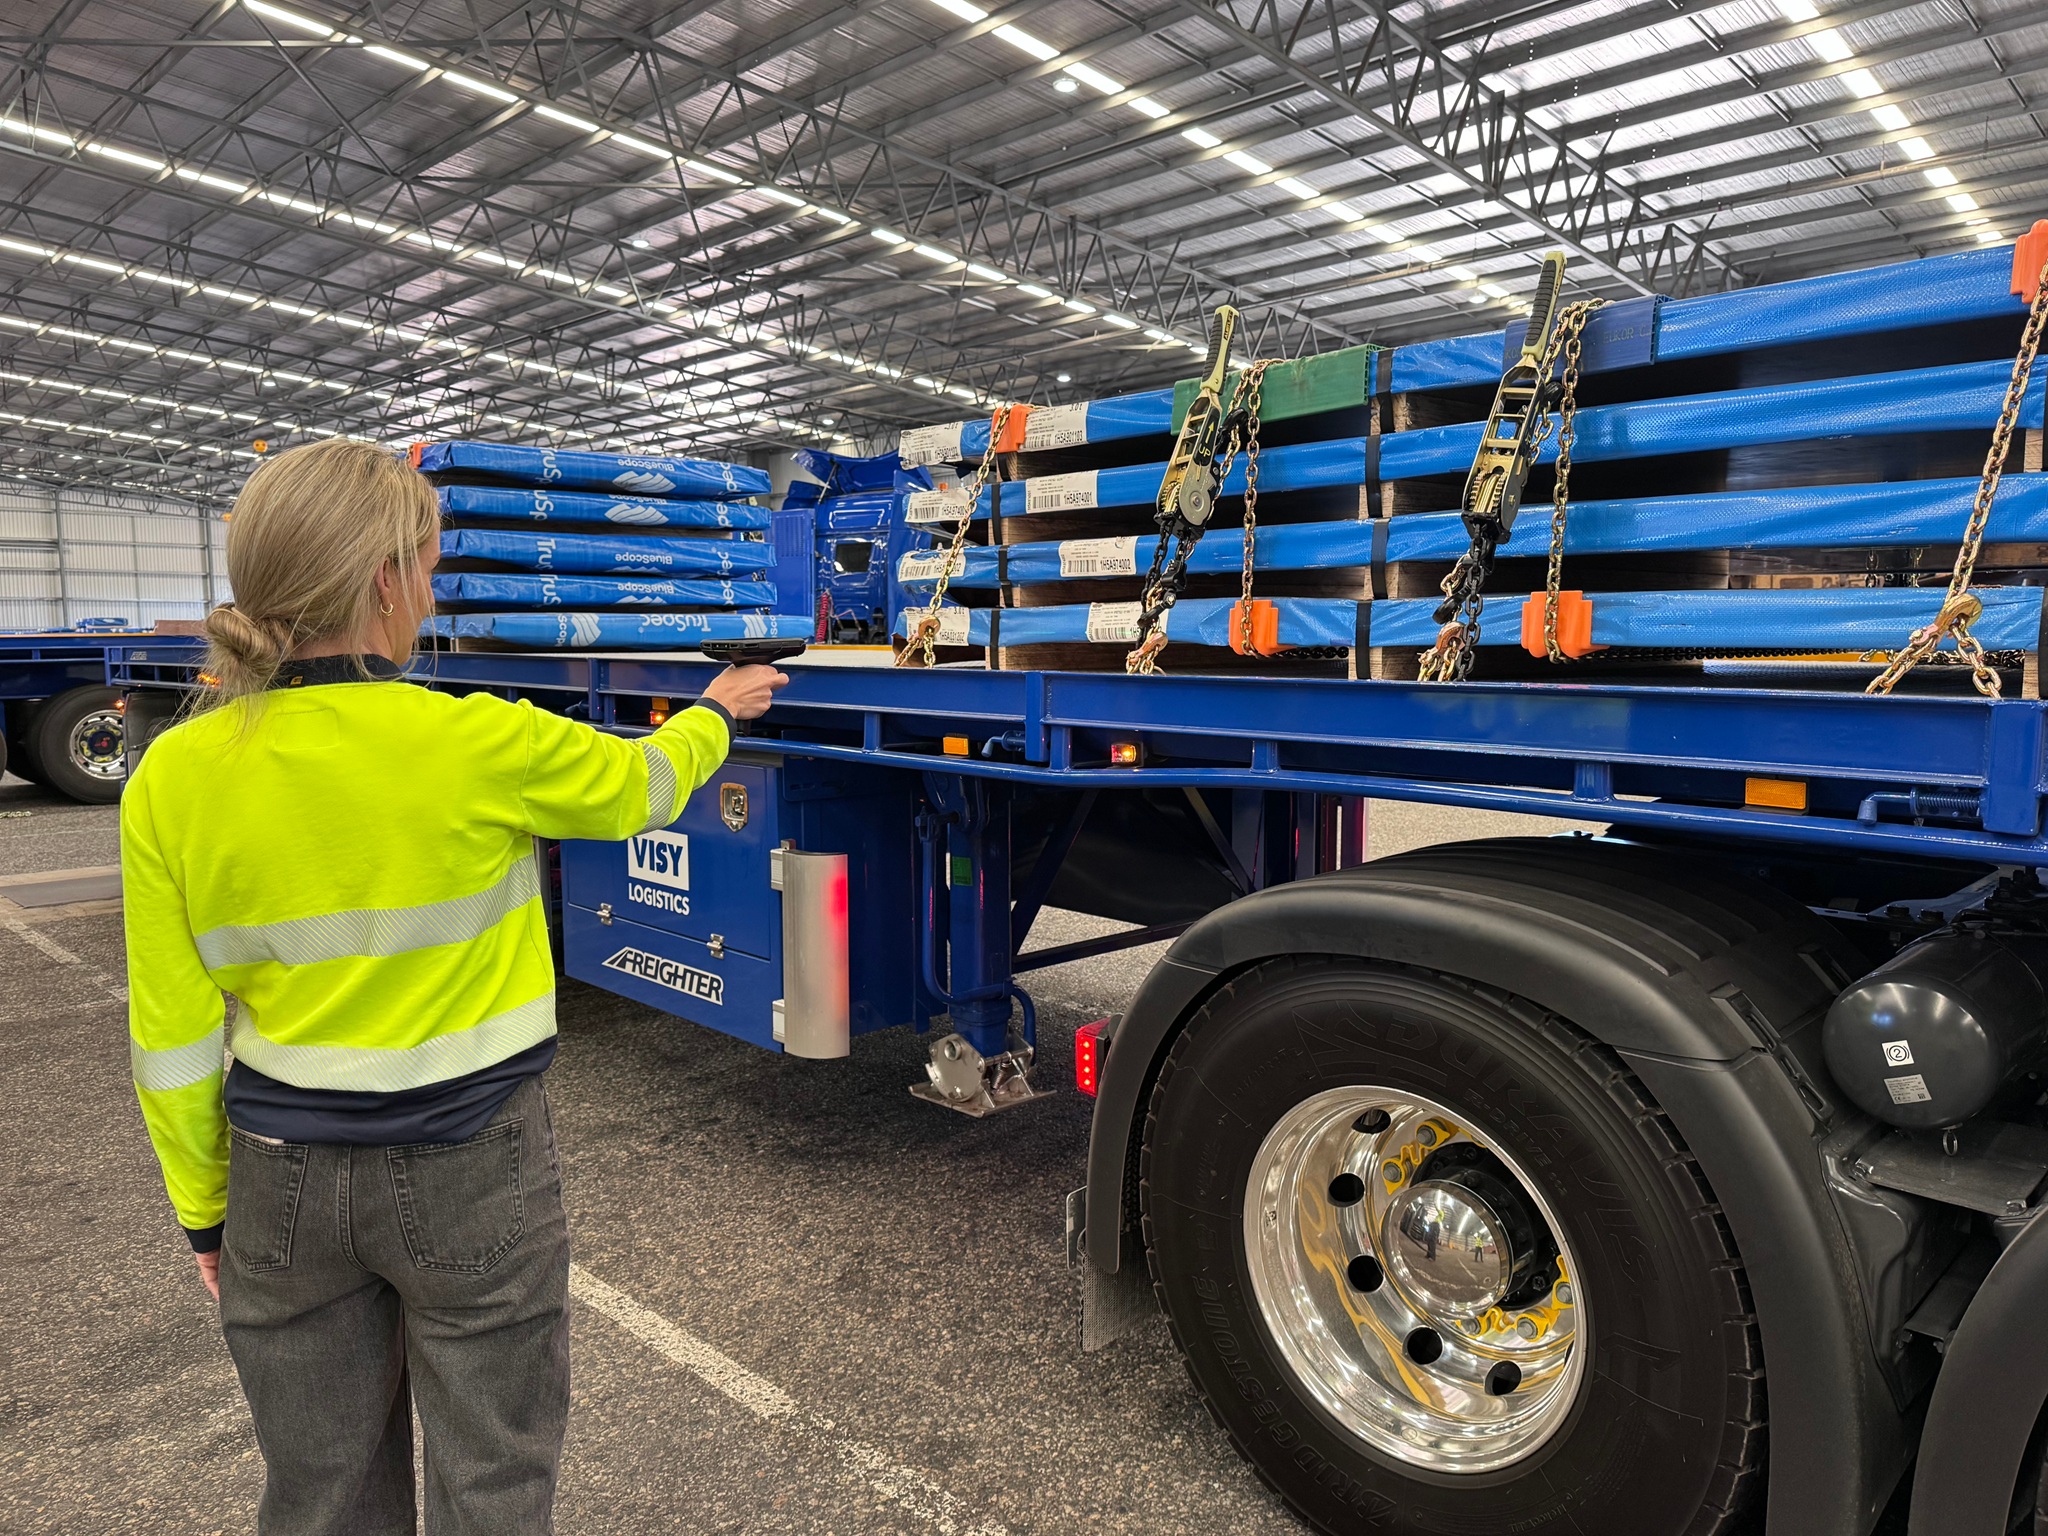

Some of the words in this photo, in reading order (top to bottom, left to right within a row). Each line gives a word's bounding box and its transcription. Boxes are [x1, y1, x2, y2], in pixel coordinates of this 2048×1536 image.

[1198, 444, 1211, 457] UP
[617, 458, 675, 472] BlueScope
[615, 552, 673, 565] BlueScope
[617, 581, 675, 594] BlueScope
[632, 836, 684, 878] VISY
[628, 882, 690, 916] LOGISTICS
[611, 949, 723, 1002] FREIGHTER
[1893, 1048, 1902, 1058] 2
[1191, 1275, 1397, 1528] BRIDGESTONE
